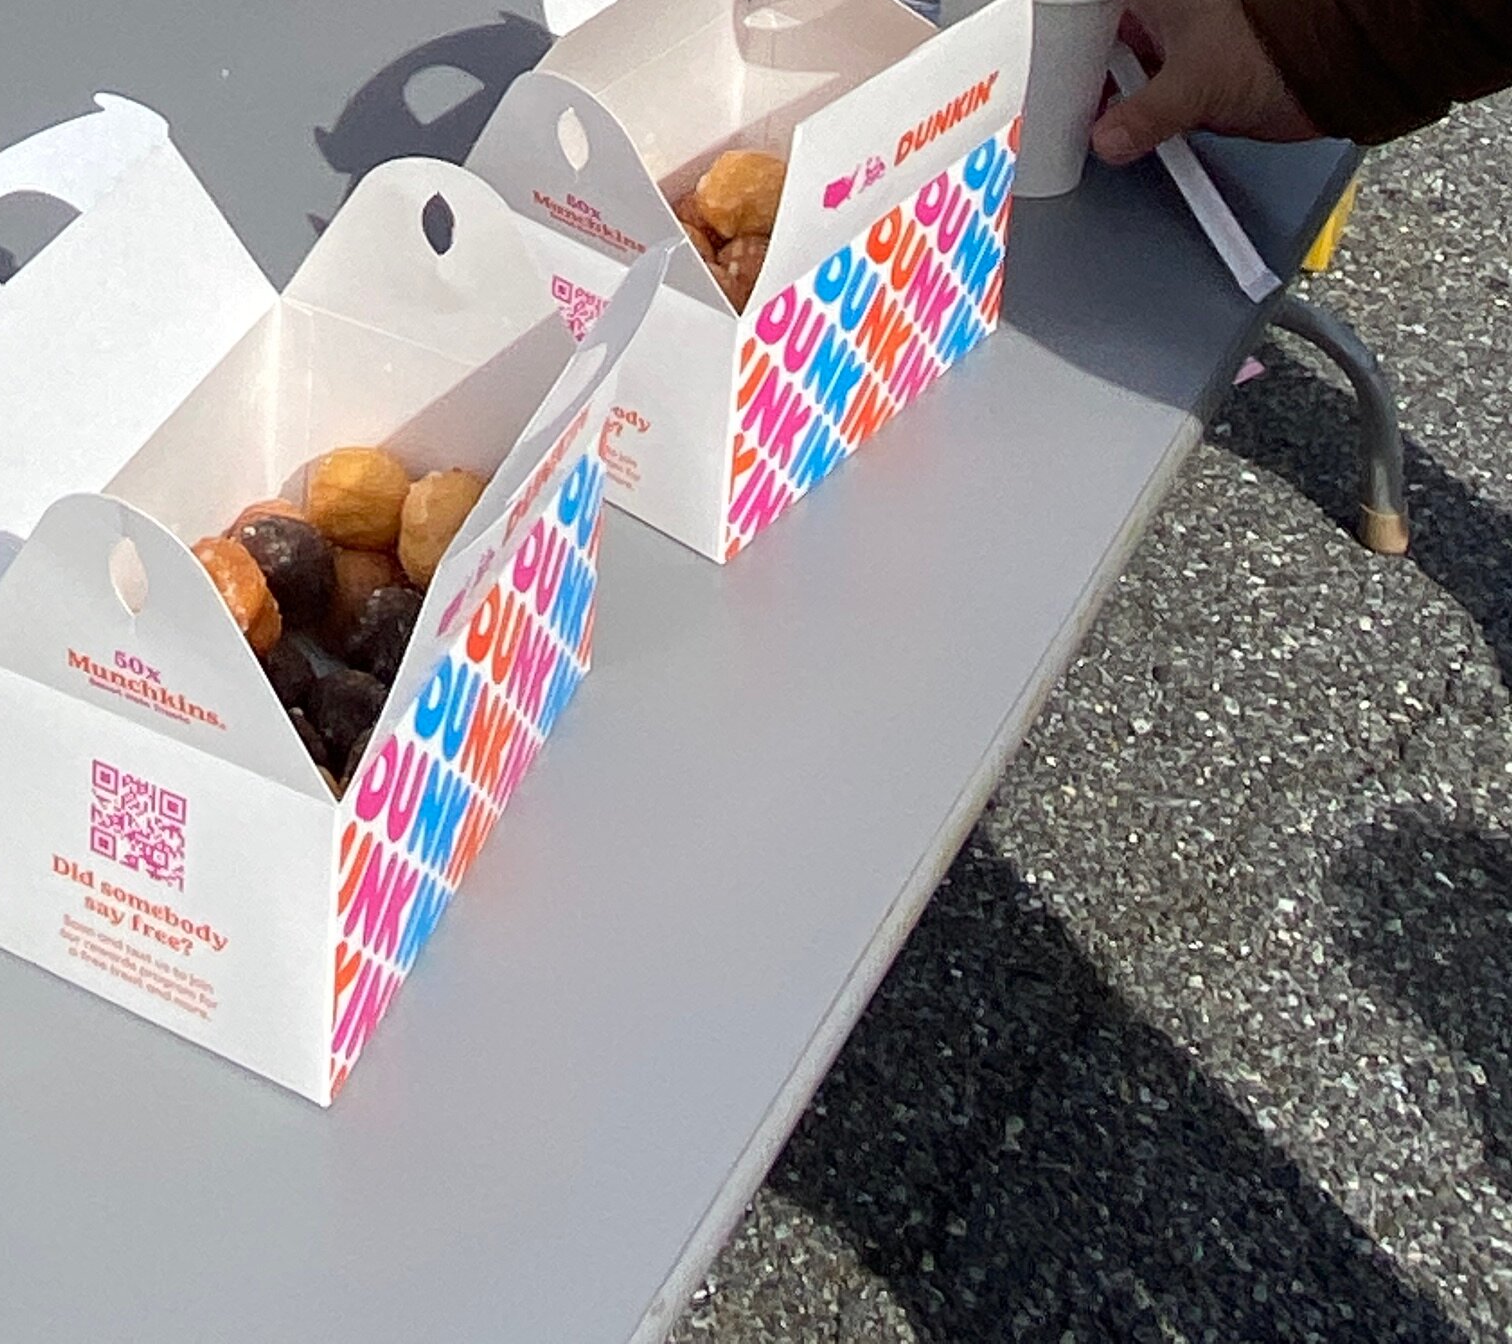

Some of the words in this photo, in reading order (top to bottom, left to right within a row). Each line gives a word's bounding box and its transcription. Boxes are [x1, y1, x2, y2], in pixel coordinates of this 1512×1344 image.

[114, 649, 162, 685] 50x
[52, 853, 94, 889] Did
[101, 880, 229, 952] somebody
[85, 895, 126, 925] say
[132, 914, 194, 957] free?
